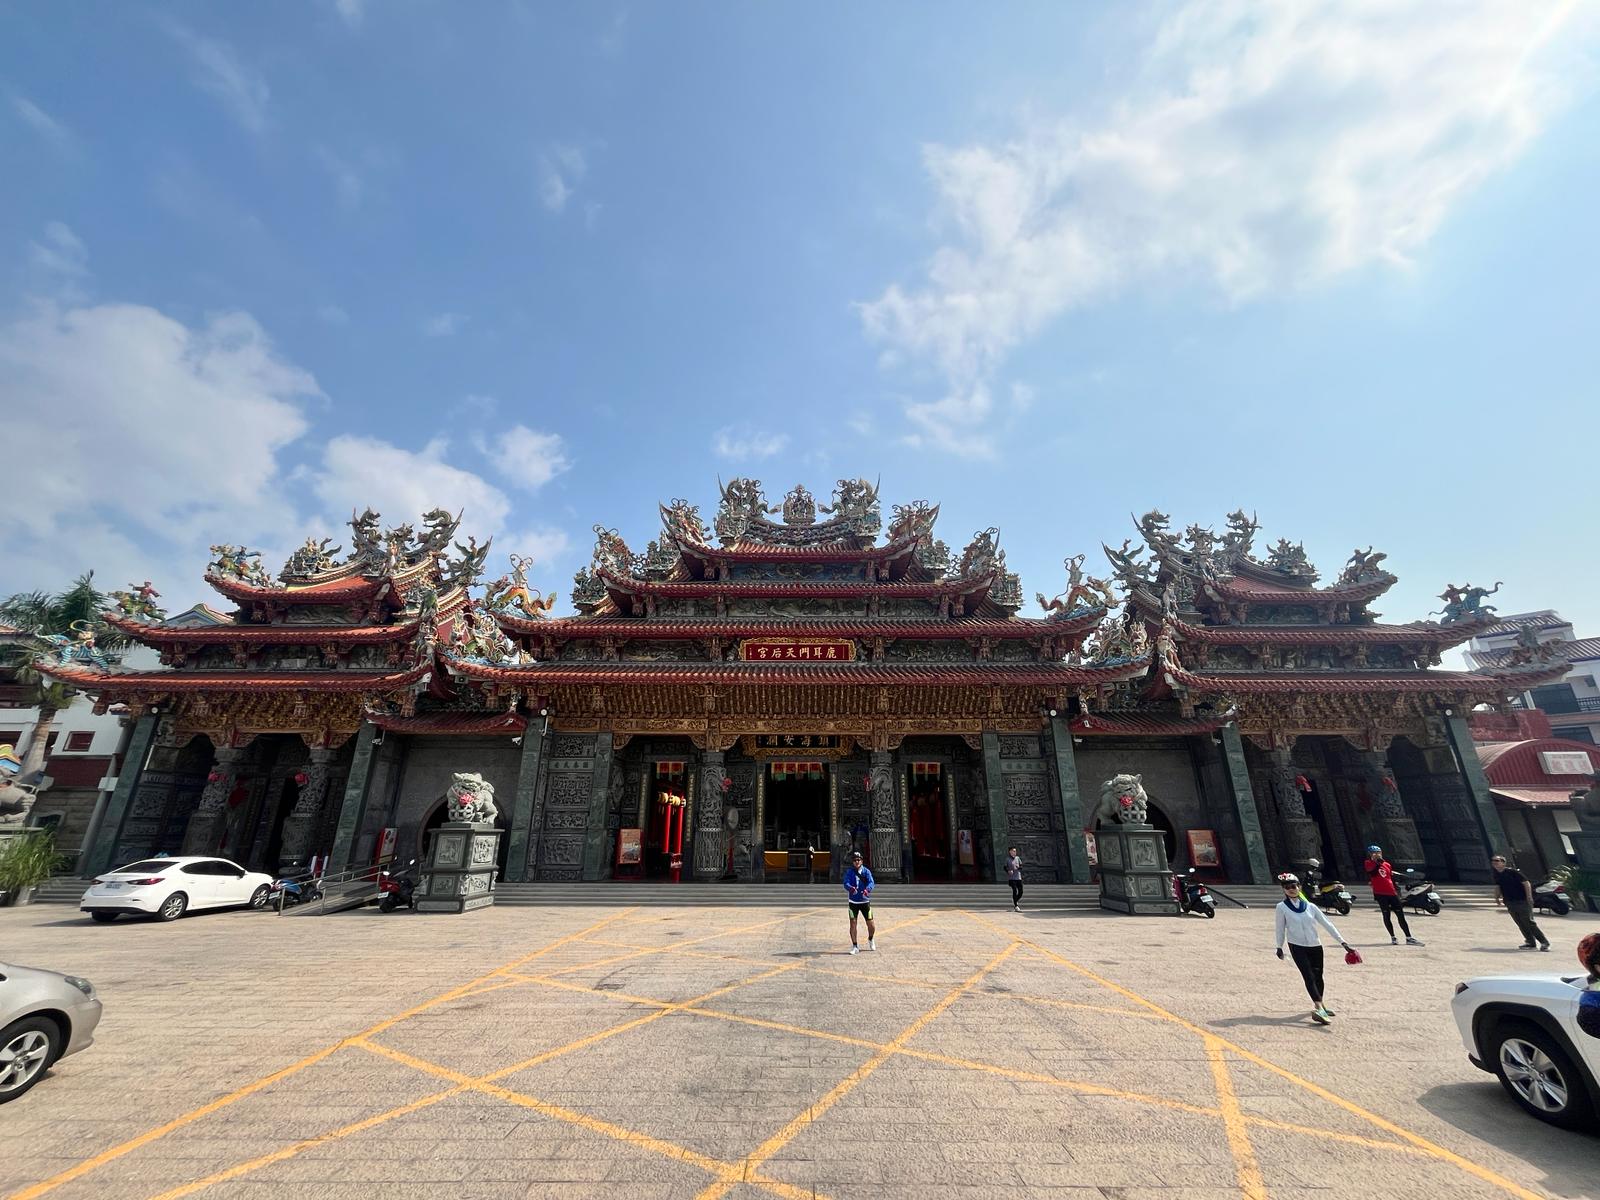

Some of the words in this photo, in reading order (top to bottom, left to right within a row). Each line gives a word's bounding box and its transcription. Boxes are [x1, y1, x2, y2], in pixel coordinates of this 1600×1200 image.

[757, 646, 837, 659] 鹿耳門天后宮
